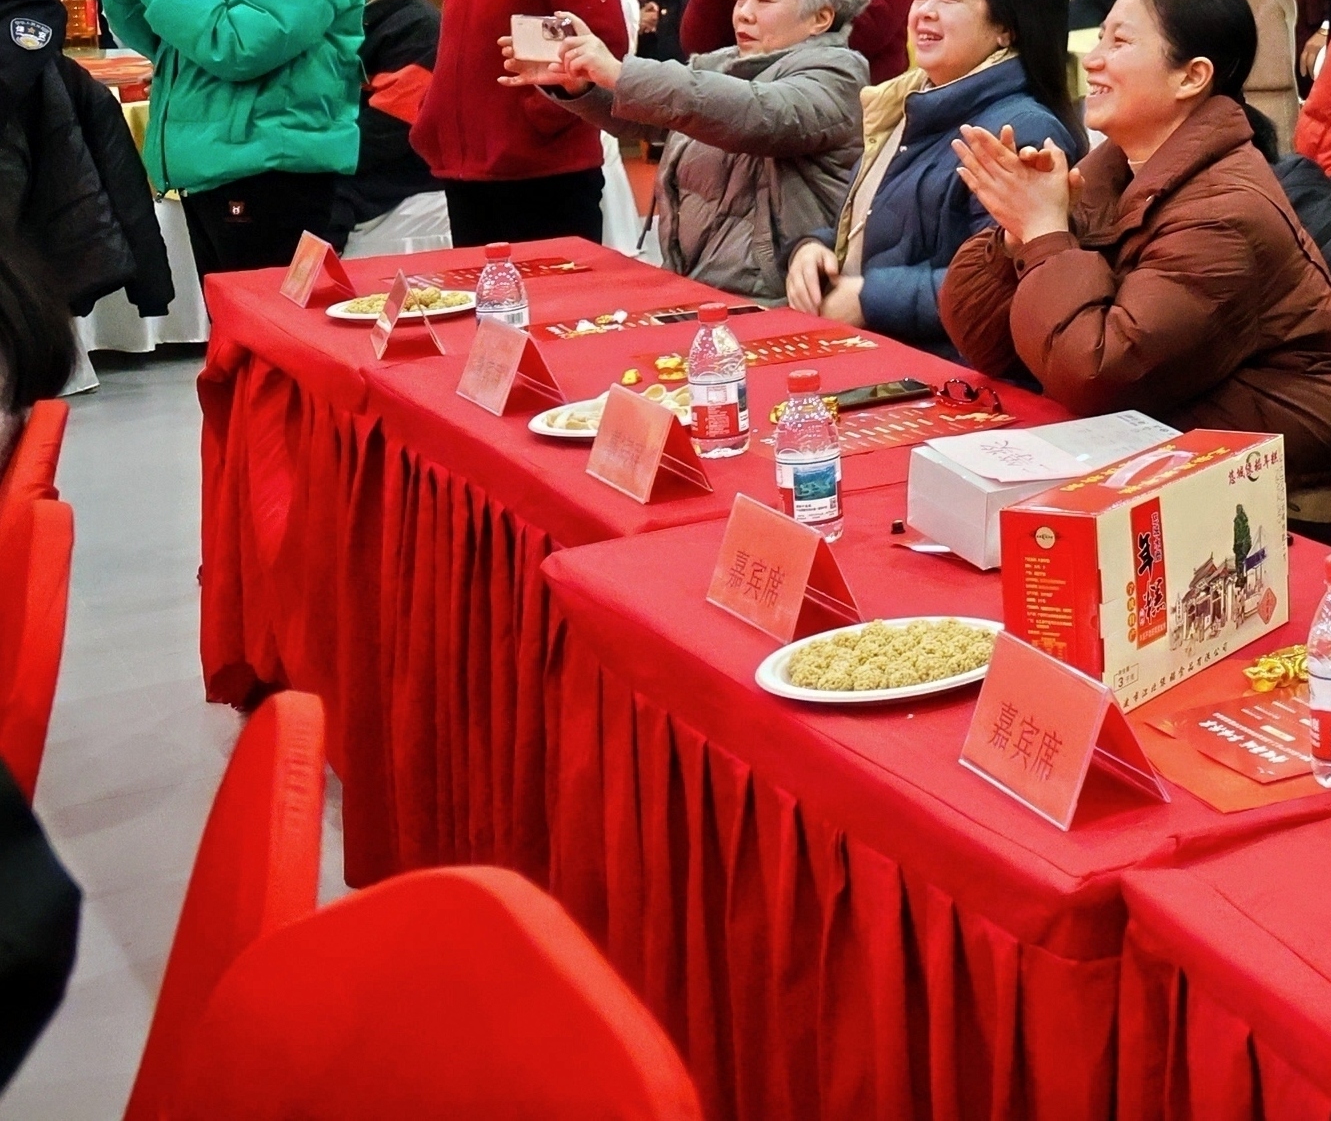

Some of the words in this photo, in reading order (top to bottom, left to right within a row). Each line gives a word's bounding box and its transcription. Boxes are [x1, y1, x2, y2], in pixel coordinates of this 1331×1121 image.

[725, 550, 785, 608] 嘉宾席
[1138, 533, 1166, 625] 年糕
[988, 701, 1063, 782] 嘉宾席
